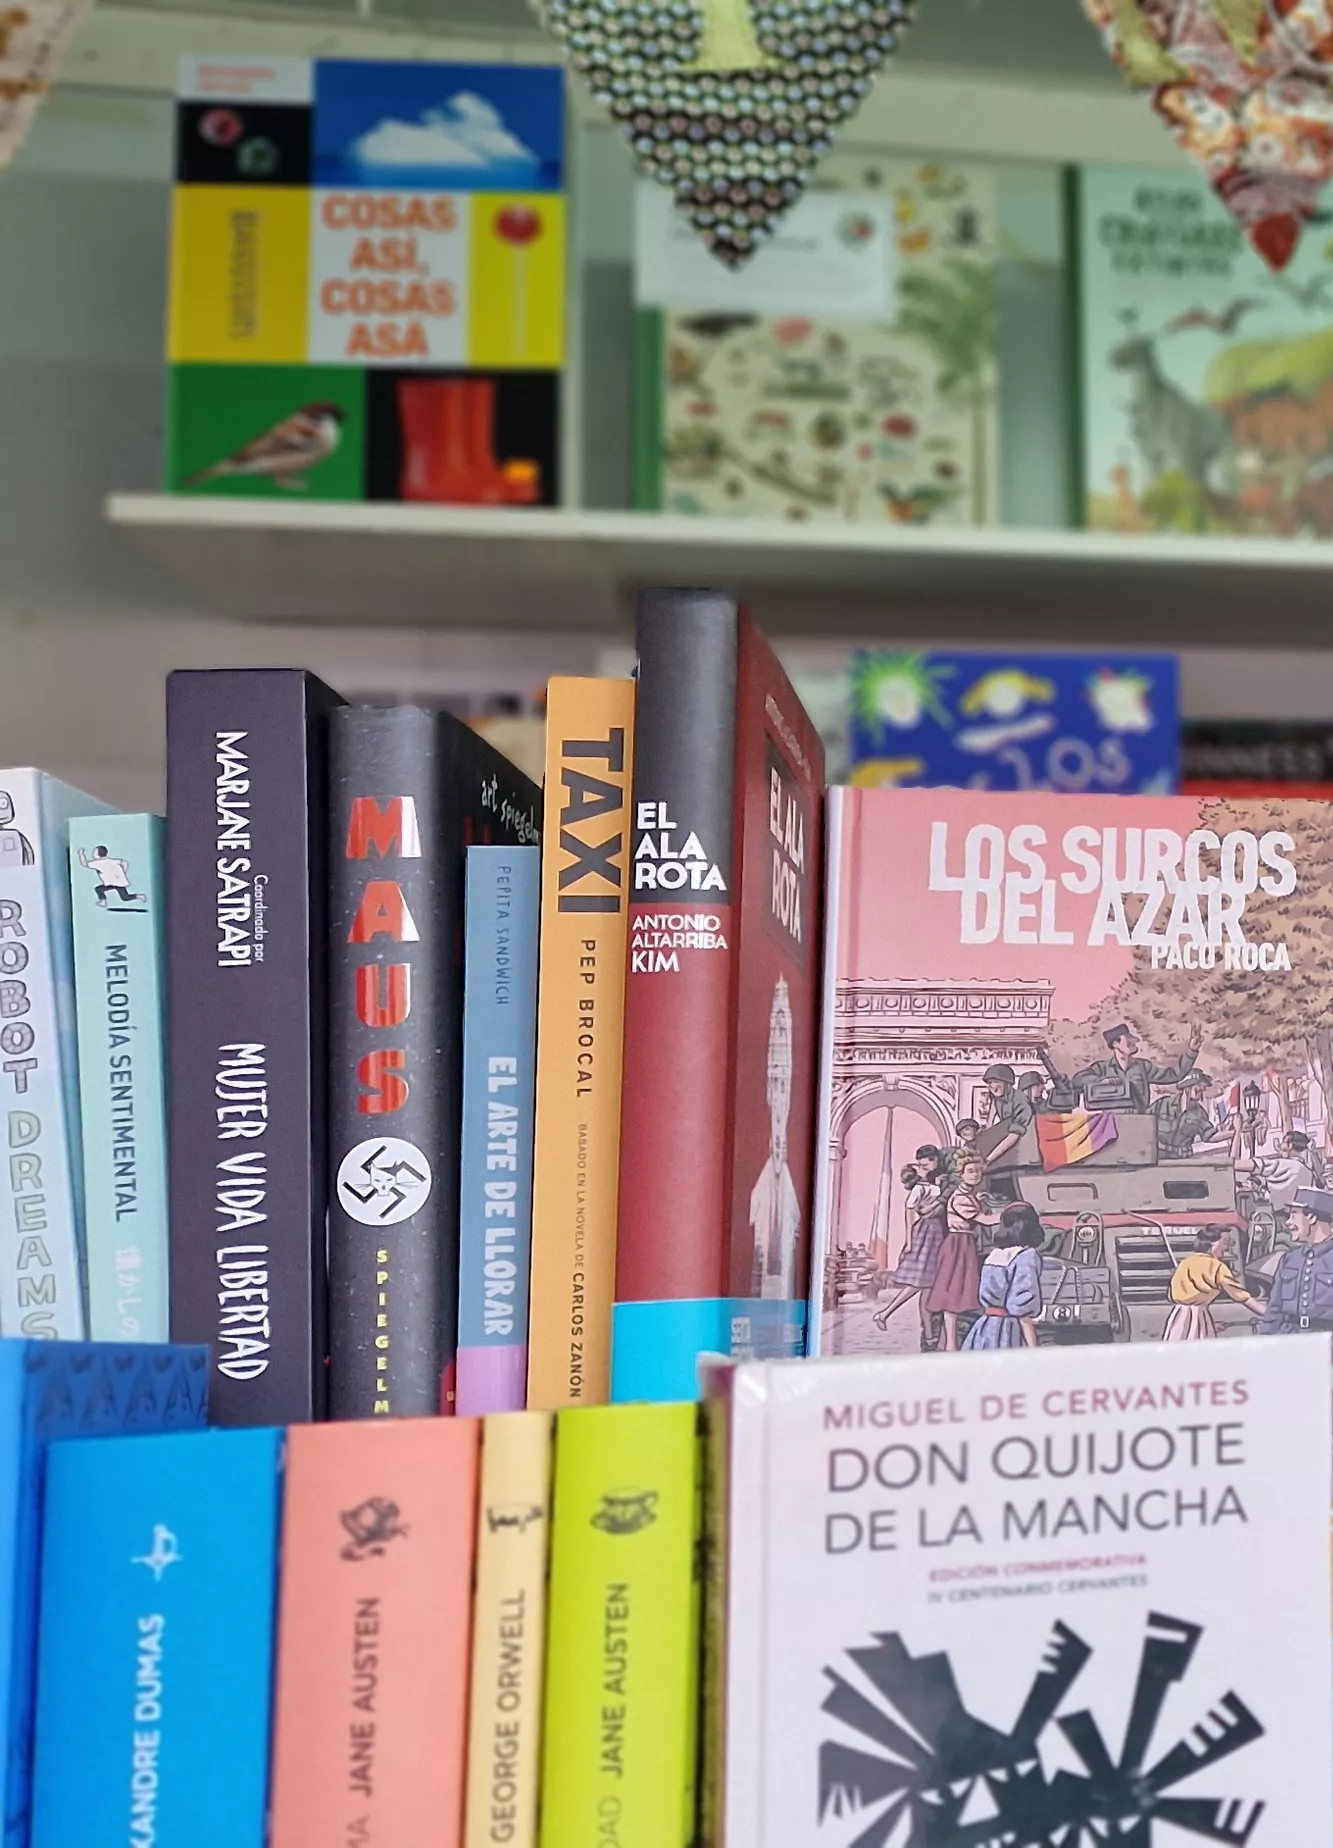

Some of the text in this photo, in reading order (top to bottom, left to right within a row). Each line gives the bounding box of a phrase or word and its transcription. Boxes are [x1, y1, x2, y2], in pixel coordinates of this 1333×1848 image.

[321, 195, 456, 230] COSAS
[320, 278, 455, 316] COSAS
[481, 774, 499, 812] art
[558, 727, 625, 913] TAXI
[637, 801, 678, 830] EL
[769, 766, 804, 875] EL ALA
[215, 730, 252, 968] MARJANE SATRAPI
[634, 831, 708, 860] ALA
[634, 861, 728, 892] ROTA
[928, 821, 1298, 898] LOS SURCOS
[253, 874, 269, 963] Coordinado por
[494, 866, 512, 1006] PEPITA SANDWICH
[631, 913, 721, 932] ANTONIO
[772, 847, 802, 945] ROTA
[960, 874, 1249, 947] DEL AZAR
[345, 796, 422, 1115] MAUS
[631, 931, 729, 950] ALTARRIBA
[631, 949, 681, 973] KIM
[1150, 941, 1292, 972] PACO ROCA
[0, 899, 38, 1094] ROBOT
[576, 939, 597, 1098] PEP BROCAL
[105, 944, 139, 1222] MELODÍA SENTIMENTAL
[8, 1110, 58, 1339] DREAMS
[215, 1043, 270, 1380] MUJER VIDA LIBERTAD
[483, 1057, 519, 1336] EL ARTE DE LLORAR
[569, 1123, 588, 1399] BASADO EN LA NOVELA DE CARLOS ZANÓN
[374, 1249, 390, 1414] SPIEGELM
[823, 1379, 1250, 1431] MIGUEL DE CERVANTES
[828, 1422, 1245, 1494] DON QUIJOTE
[824, 1485, 1249, 1555] DE LA MANCHA
[928, 1554, 1148, 1583] EDICIÓN CONMEMORATIVA
[947, 1581, 1052, 1604] CENTENARIO
[1057, 1573, 1149, 1594] CERVANTES
[134, 1613, 165, 1722] DUMAS
[351, 1597, 381, 1713] AUSTEN
[602, 1582, 629, 1697] AUSTEN
[490, 1588, 526, 1844] GEORGE ORWELL
[599, 1704, 626, 1780] JANE
[347, 1721, 377, 1800] JANE
